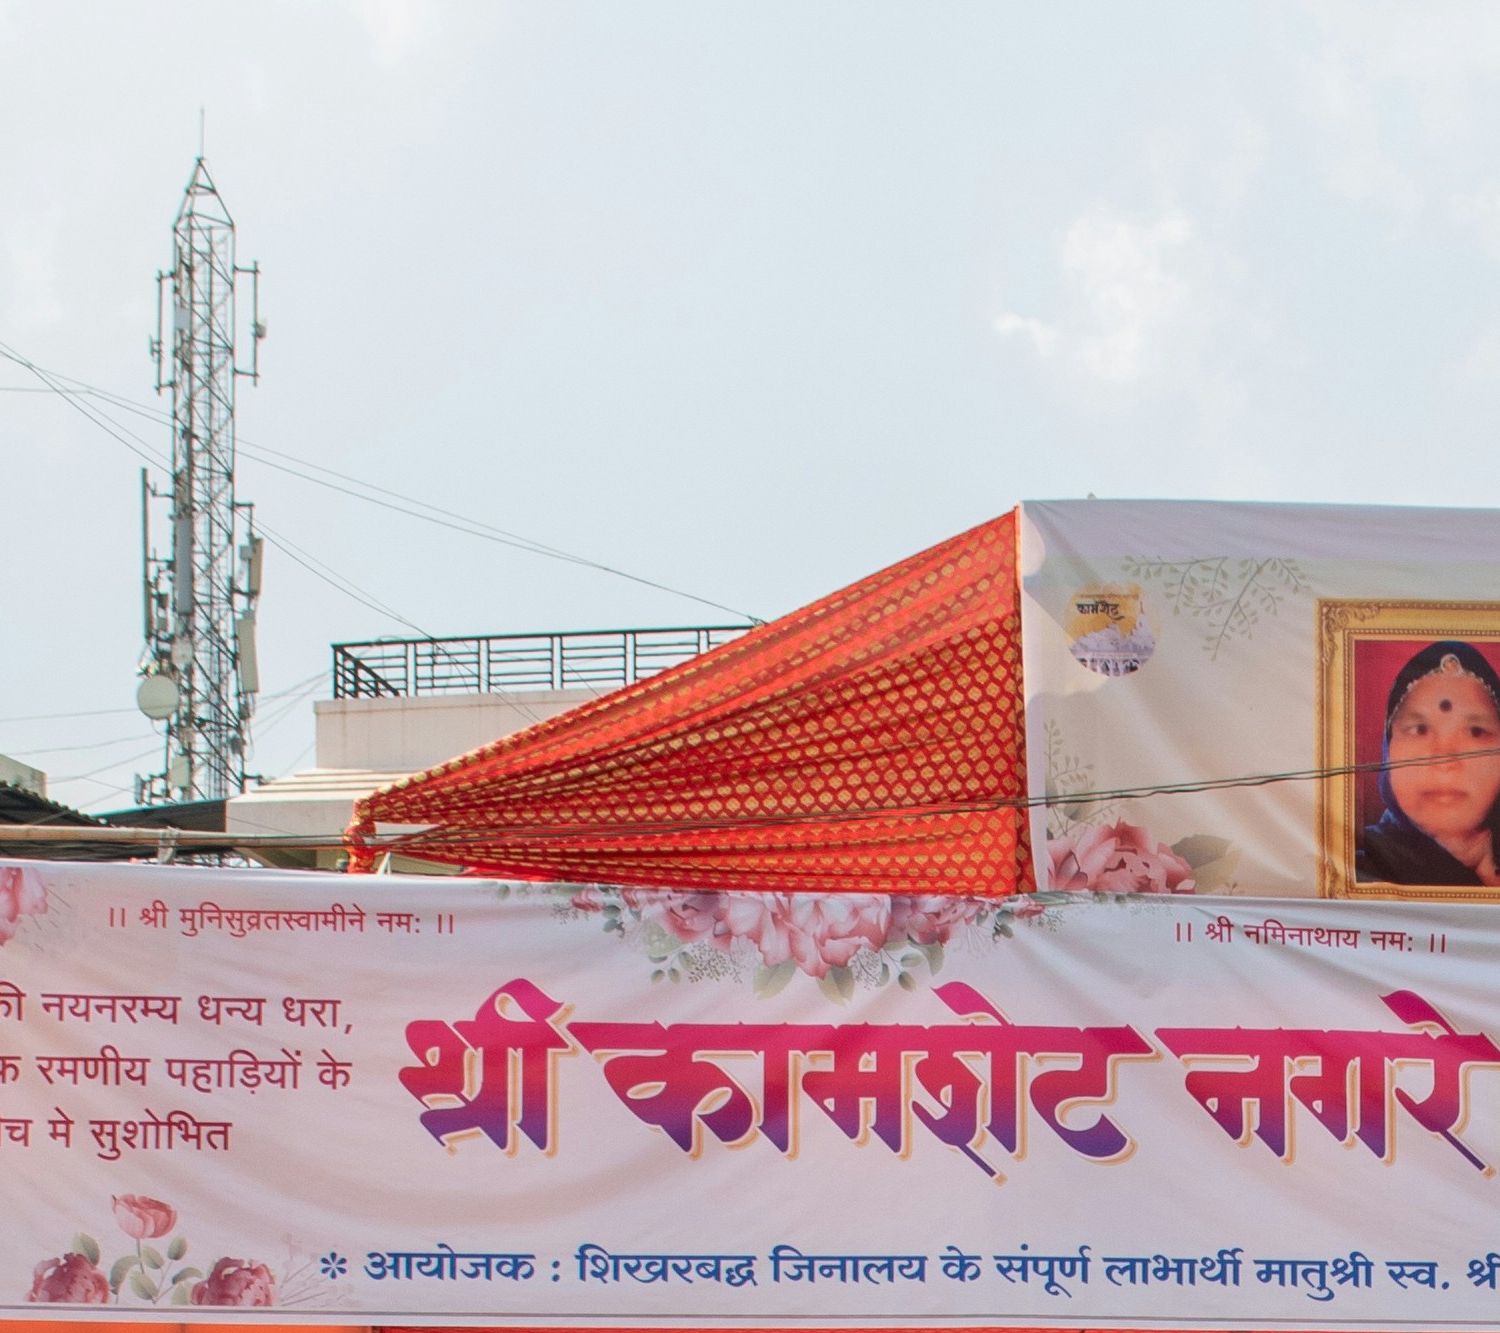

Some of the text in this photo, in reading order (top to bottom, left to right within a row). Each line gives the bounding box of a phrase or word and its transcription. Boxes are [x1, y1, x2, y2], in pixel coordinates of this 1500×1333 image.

[139, 904, 168, 934] श्री
[1205, 917, 1234, 947] श्री
[41, 993, 180, 1025] नयनरम्य
[198, 994, 266, 1027] धन्य
[37, 1046, 148, 1088] रमणीय
[316, 1048, 352, 1091] के
[399, 977, 580, 1157] श्री
[570, 979, 1161, 1183] कामशेट
[91, 1111, 231, 1161] सुशोभित
[364, 1245, 536, 1283] आयोजक
[578, 1244, 756, 1289] शिखरबद्ध
[770, 1244, 926, 1284] जिनालय
[942, 1245, 980, 1286] के
[994, 1244, 1092, 1298] संपूर्ण
[1103, 1248, 1240, 1289] लाभार्थी
[1254, 1251, 1373, 1303] मातुश्री
[1387, 1258, 1449, 1292] स्व.
